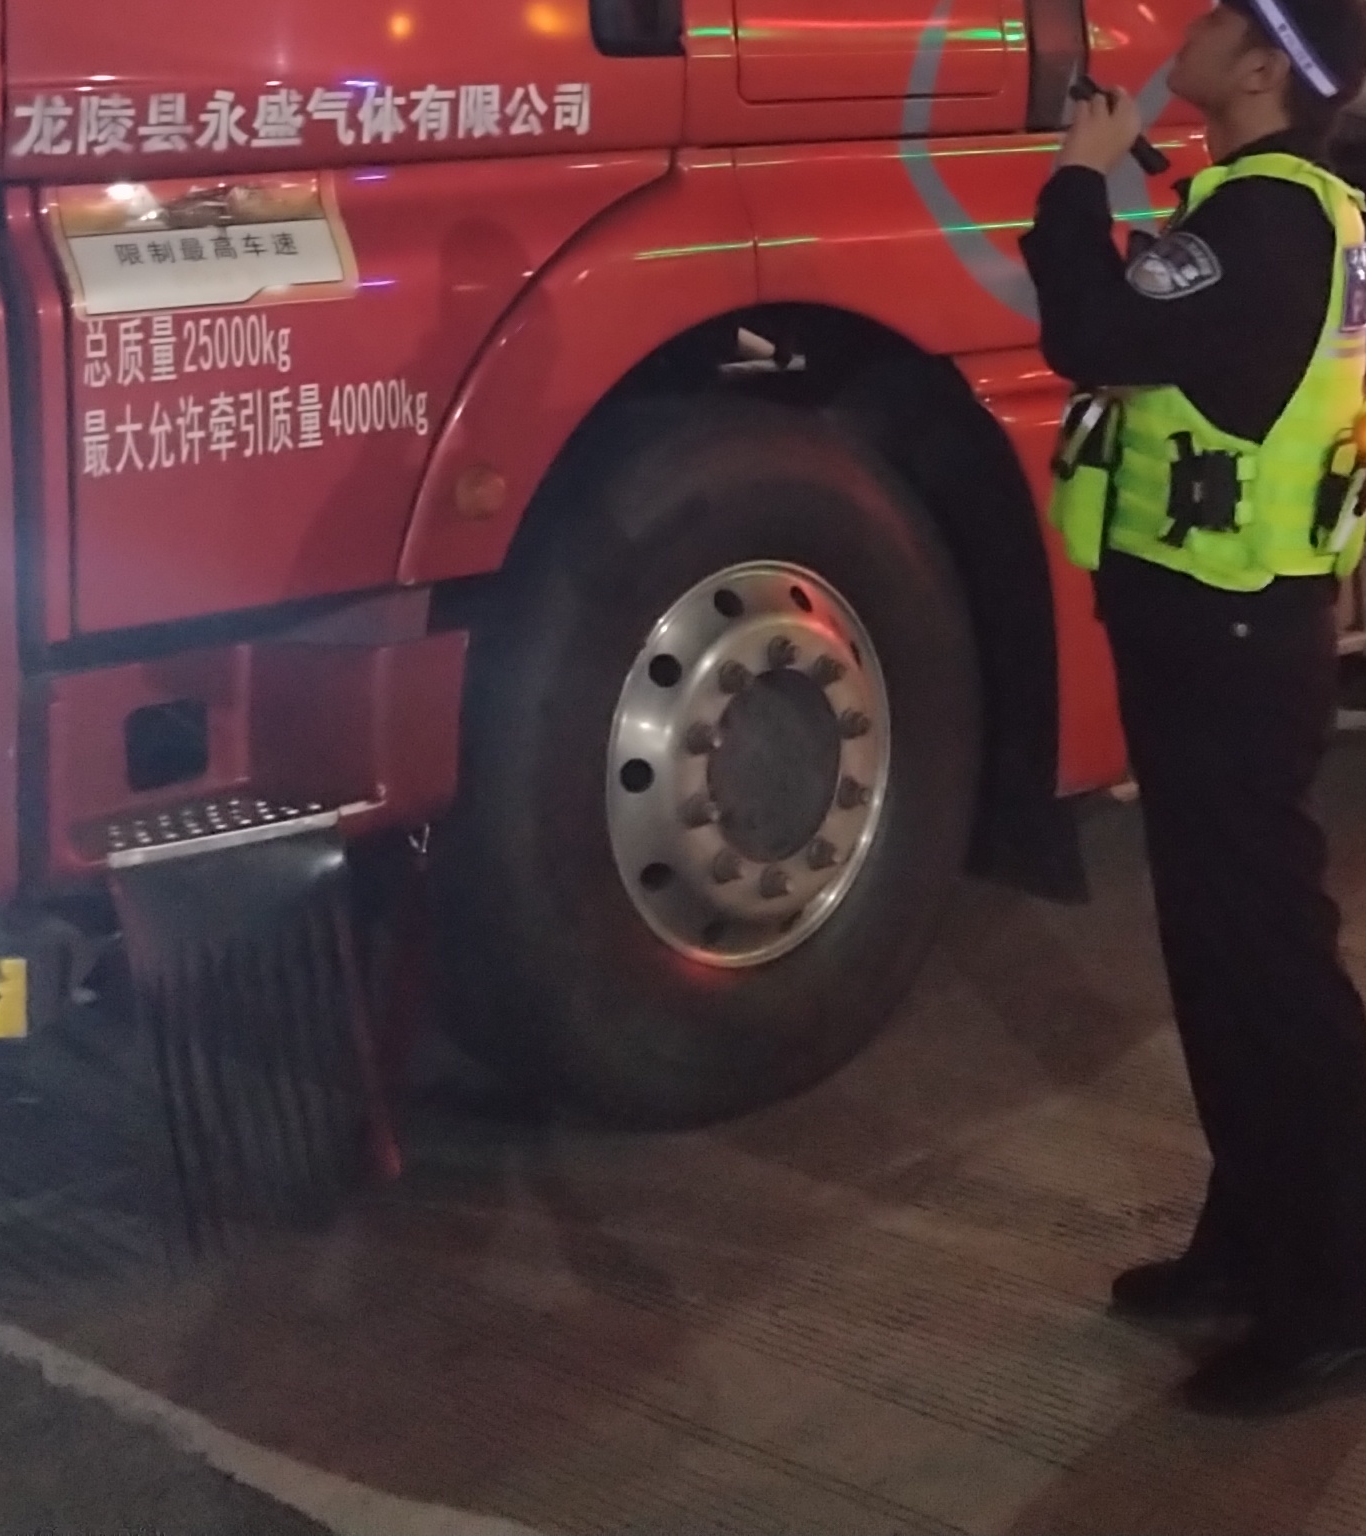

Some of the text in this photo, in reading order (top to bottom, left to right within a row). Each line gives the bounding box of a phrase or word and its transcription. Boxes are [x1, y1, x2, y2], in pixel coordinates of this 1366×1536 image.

[11, 82, 592, 157] 龙陵县永盛气体有限公司
[114, 232, 299, 266] 限制最高车速
[82, 313, 291, 389] 总质量25000kg
[81, 379, 429, 478] 最大允许牵引质量40000kg
